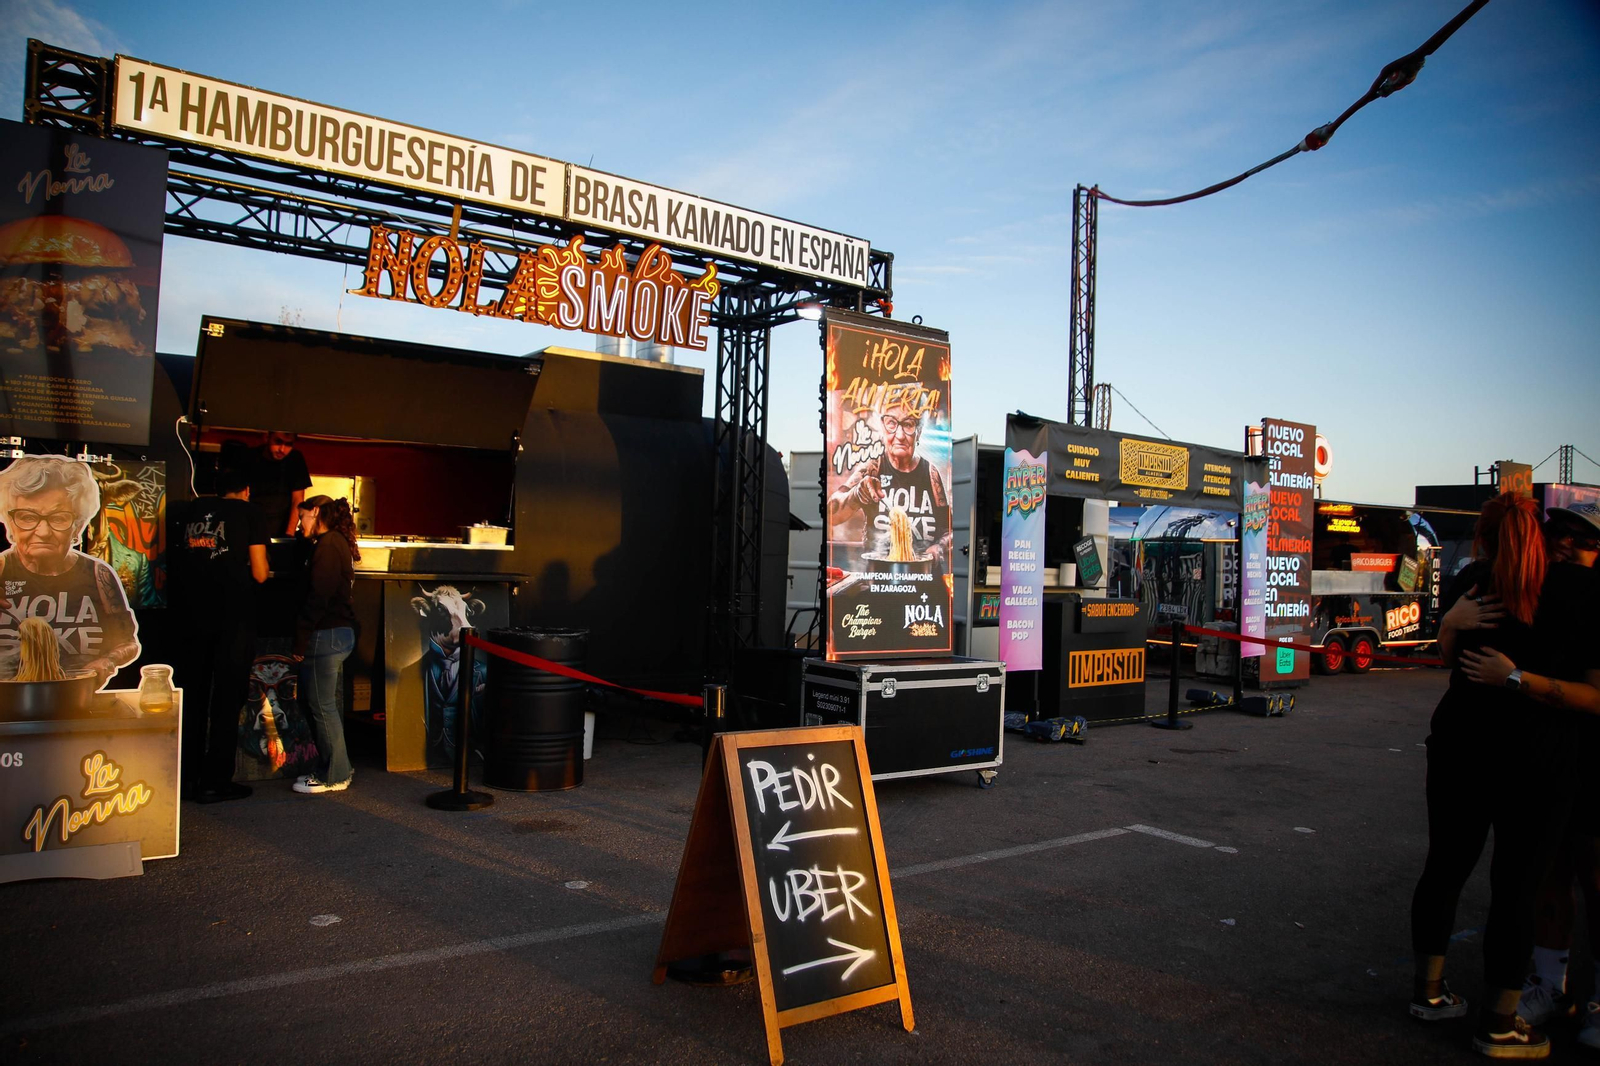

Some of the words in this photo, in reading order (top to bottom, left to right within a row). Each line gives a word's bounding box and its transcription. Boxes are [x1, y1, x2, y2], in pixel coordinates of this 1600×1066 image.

[64, 143, 91, 173] La
[18, 169, 115, 204] Nonna
[180, 82, 495, 196] HAMBURGUESERÍA
[511, 160, 547, 206] DE
[573, 175, 659, 233] BRASA
[667, 199, 764, 257] KAMADO
[770, 226, 794, 265] EN
[799, 233, 866, 282] ESPAÑA
[347, 224, 550, 327] NOLA
[559, 264, 709, 350] SMOKE
[0, 386, 35, 394] EMI-GLACE
[1268, 424, 1304, 442] NUEVO
[1067, 444, 1099, 457] CUIDADO
[1268, 440, 1303, 458] LOCAL
[1073, 458, 1090, 468] MUY
[1204, 463, 1231, 474] ATENCIÓN
[1007, 464, 1046, 489] HYPER
[1065, 470, 1100, 482] CALIENTE
[1203, 474, 1230, 485] ATENCIÓN
[1202, 485, 1230, 496] ATENCIÓN
[1006, 486, 1045, 516] POP
[184, 521, 226, 541] NOLA
[874, 515, 936, 541] SKE
[1014, 540, 1031, 549] PAN
[1266, 535, 1311, 553] ALMERÍA
[1008, 549, 1036, 560] RECIÉN
[1010, 562, 1036, 572] HECHO
[853, 571, 893, 581] CAMPEONA
[894, 572, 934, 582] CHAMPIONS
[870, 585, 880, 593] EN
[880, 585, 917, 593] ZARAGOZA
[1012, 585, 1033, 595] VACA
[1004, 597, 1038, 606] GALLEGA
[1087, 603, 1106, 617] SABOR
[1264, 600, 1310, 617] ALMERÍA
[903, 605, 944, 629] NOLA
[1006, 620, 1034, 629] BACON
[1386, 601, 1421, 631] RICO
[1011, 632, 1029, 640] POP
[1388, 628, 1403, 639] FOOD
[1403, 624, 1420, 634] TRUCK
[0, 627, 103, 656] SKE
[85, 753, 119, 796] La
[747, 753, 854, 814] PEDIR
[25, 783, 150, 852] Nonna
[769, 865, 876, 922] UBER
